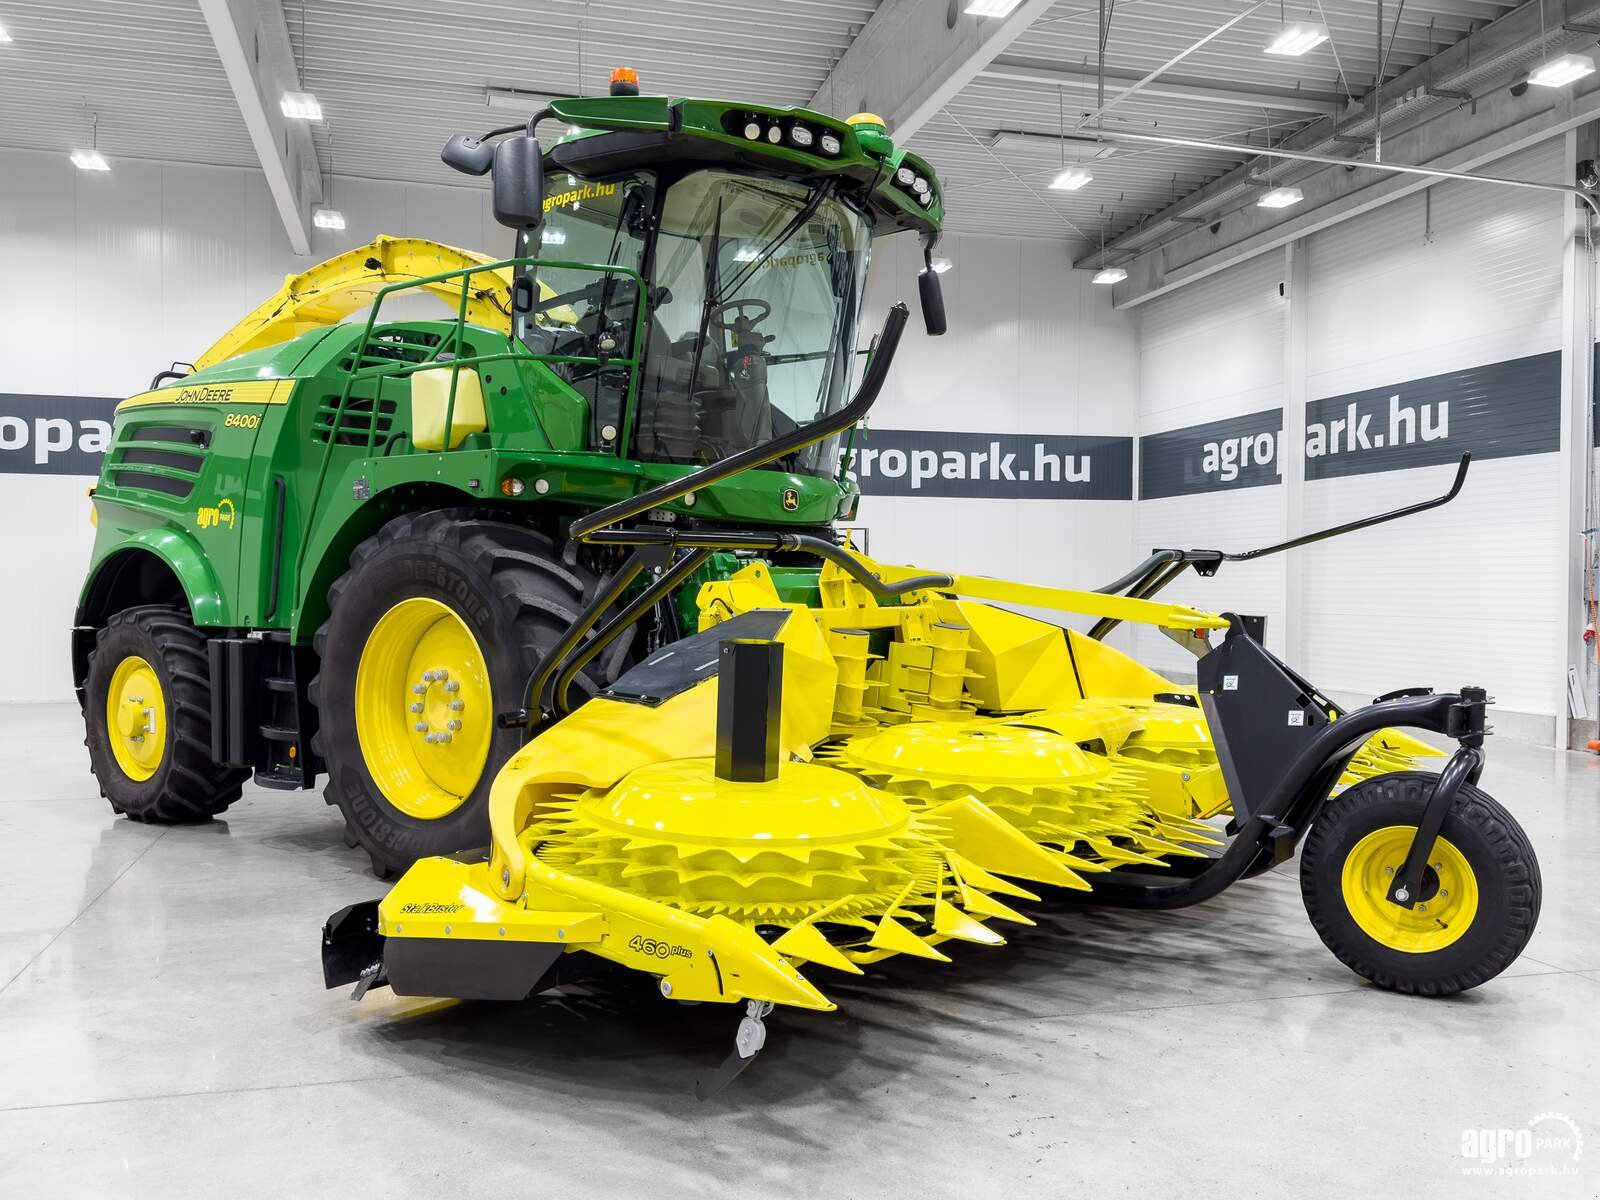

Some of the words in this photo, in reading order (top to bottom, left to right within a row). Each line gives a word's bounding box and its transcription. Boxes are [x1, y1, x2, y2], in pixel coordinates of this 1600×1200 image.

[174, 388, 202, 402] JOHN
[200, 387, 233, 401] DEERE
[224, 412, 262, 429] 8400i
[0, 416, 113, 465] opa
[1202, 394, 1449, 481] agroark.hu
[834, 441, 1091, 489] gropark.hu
[197, 507, 219, 528] agro
[628, 935, 670, 959] 460
[671, 945, 693, 959] plus
